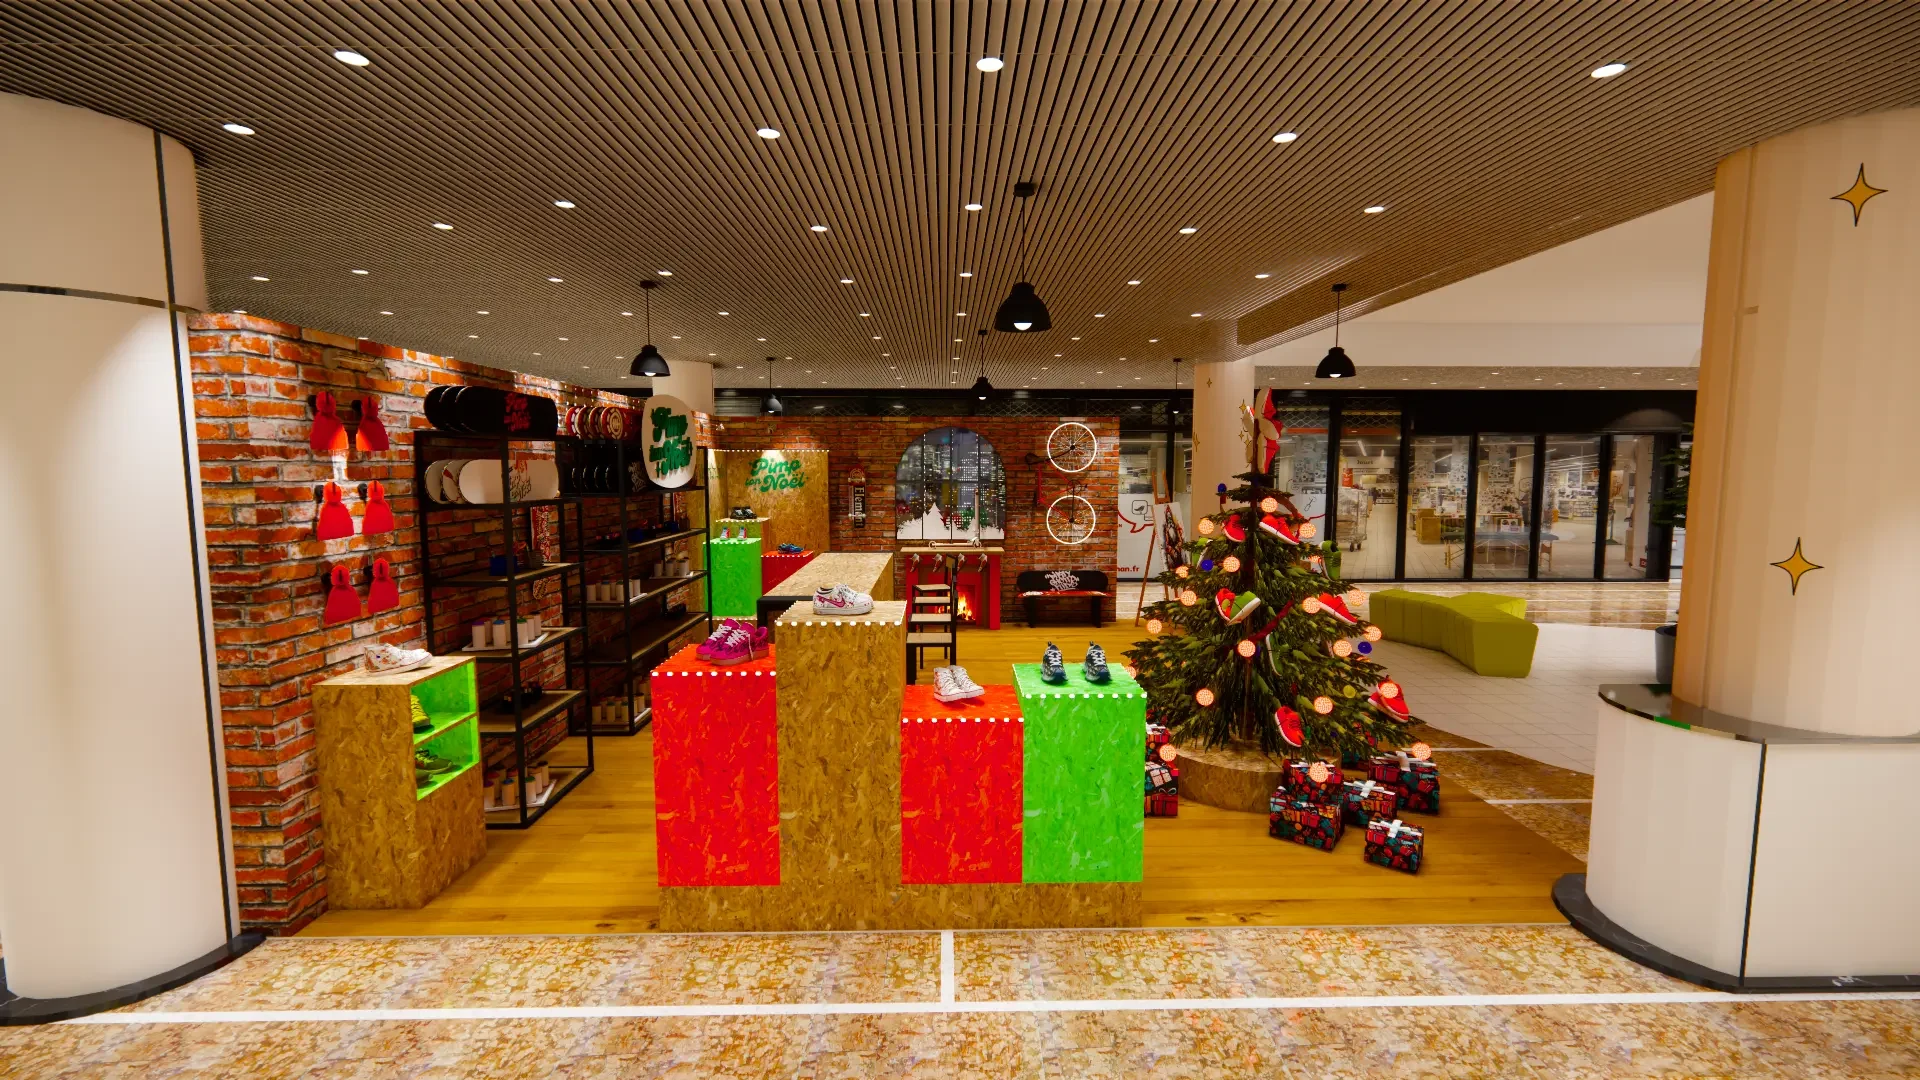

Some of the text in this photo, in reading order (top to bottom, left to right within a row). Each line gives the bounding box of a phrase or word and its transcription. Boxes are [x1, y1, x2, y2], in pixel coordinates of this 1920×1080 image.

[751, 458, 801, 476] Pimp
[745, 472, 804, 492] ton Noël
